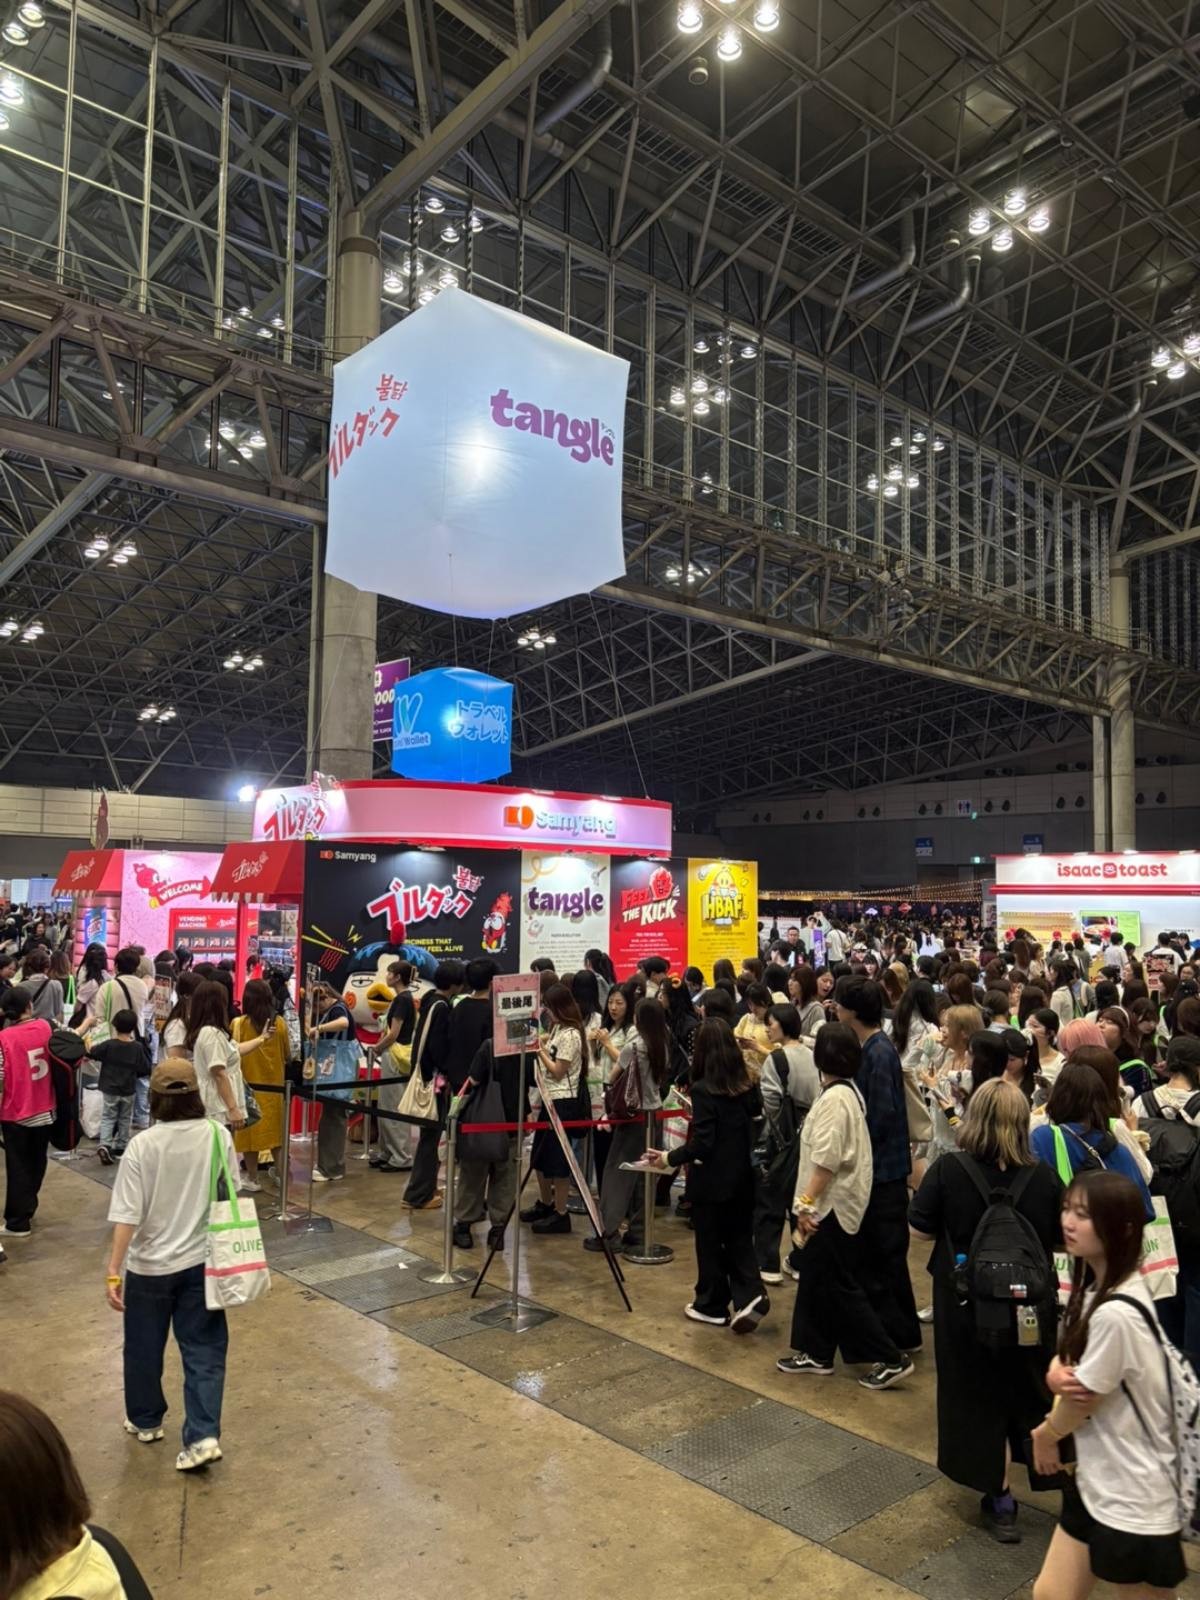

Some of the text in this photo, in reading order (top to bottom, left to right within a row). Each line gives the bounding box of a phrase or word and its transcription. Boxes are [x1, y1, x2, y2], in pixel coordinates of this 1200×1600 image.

[377, 373, 408, 401] 불닭
[490, 388, 614, 467] tangle
[328, 406, 400, 479] ブルダック
[456, 700, 506, 723] トラベル
[1057, 862, 1168, 877] isaac toast
[158, 881, 203, 901] WELCOME
[366, 877, 473, 931] ブルダック
[527, 886, 604, 919] tangle
[622, 897, 678, 926] THE KICK
[702, 893, 744, 921] HBAF
[444, 944, 463, 952] ALIVE
[27, 1047, 49, 1081] 5
[233, 1238, 262, 1254] OLIVE
